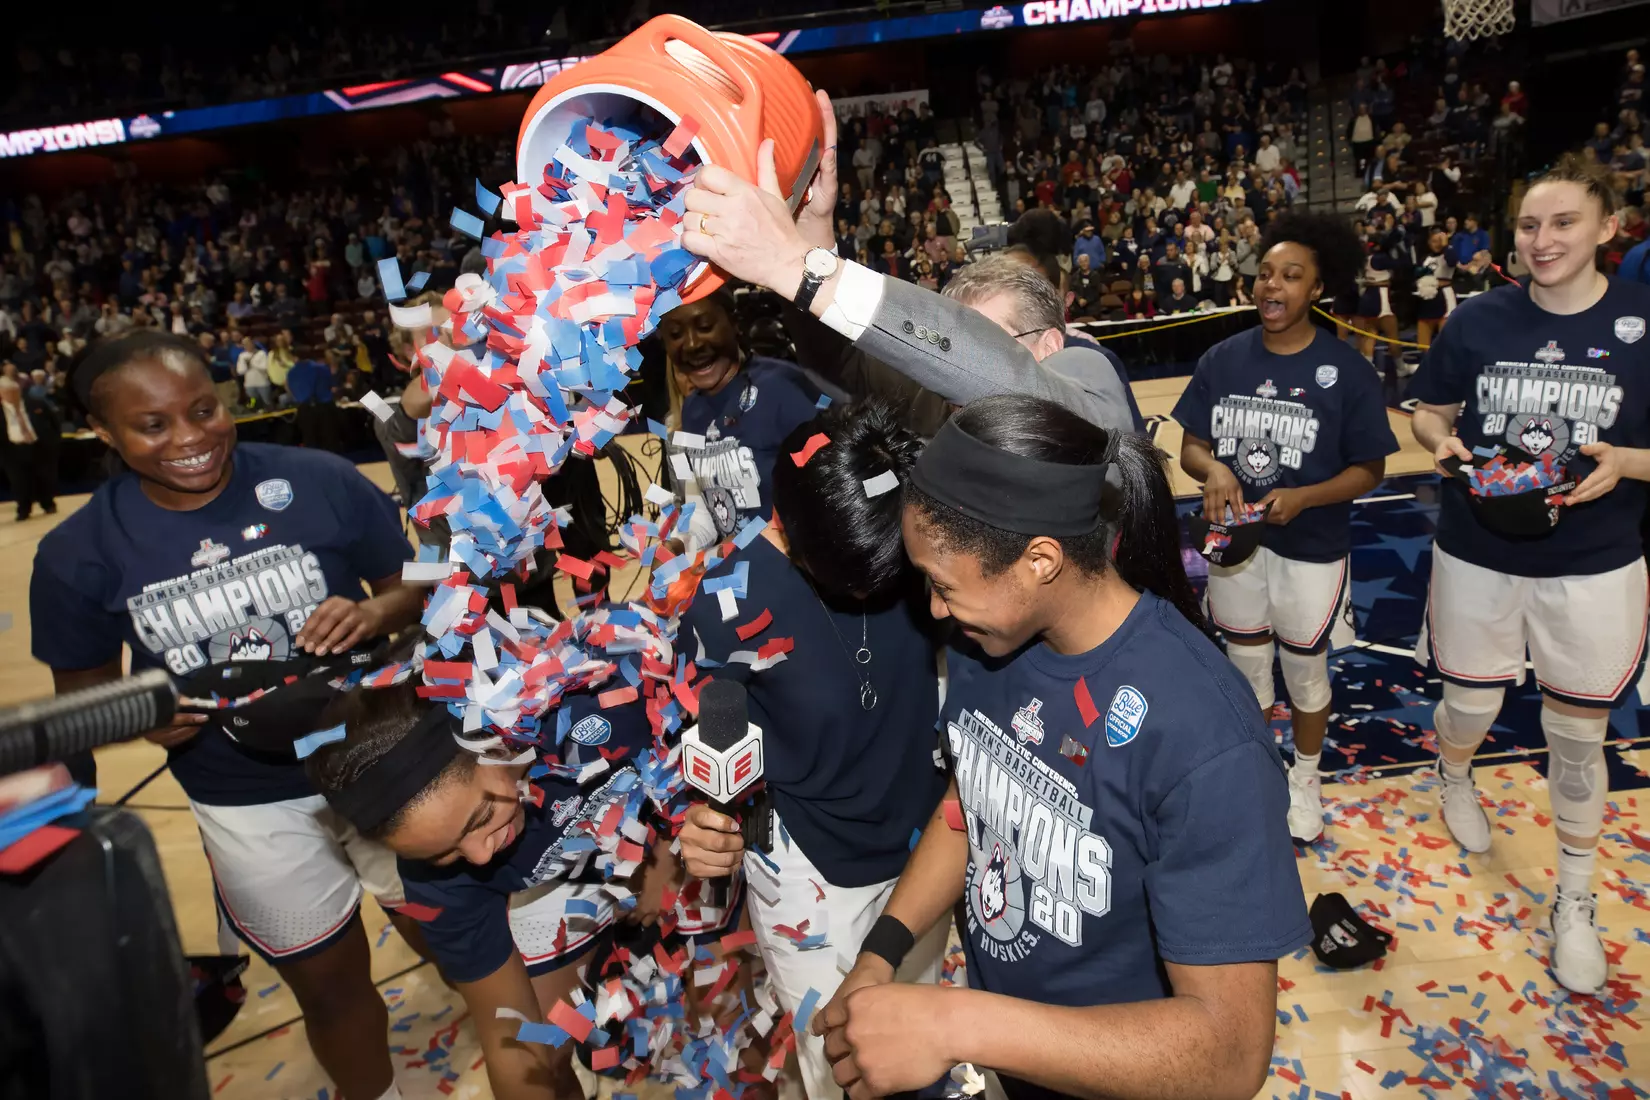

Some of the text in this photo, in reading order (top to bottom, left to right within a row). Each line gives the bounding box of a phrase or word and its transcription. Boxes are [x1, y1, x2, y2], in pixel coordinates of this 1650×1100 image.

[1023, 0, 1231, 26] CHAMPIO
[1537, 371, 1612, 383] BASKETBALL
[1257, 402, 1310, 416] BASKETBALL
[1476, 374, 1624, 430] CHAMPIONS
[1211, 404, 1319, 454] CHAMPIONS
[1482, 413, 1598, 445] 20 20
[1217, 436, 1302, 471] 20 20
[1232, 460, 1252, 484] UCONN
[133, 579, 199, 607] WOMEN'S
[206, 548, 298, 584] BASKETBALL
[132, 551, 328, 654] CHAMPIONS
[165, 643, 208, 675] 20
[1114, 691, 1143, 713] Blue
[575, 718, 596, 739] Blue
[973, 709, 1003, 739] AMERICAN
[1002, 732, 1031, 761] ATHLETIC
[1110, 713, 1131, 735] OFFICIAL
[963, 713, 1001, 755] WOMEN'S
[1005, 753, 1084, 824] BASKETBALL
[1030, 880, 1082, 948] 20
